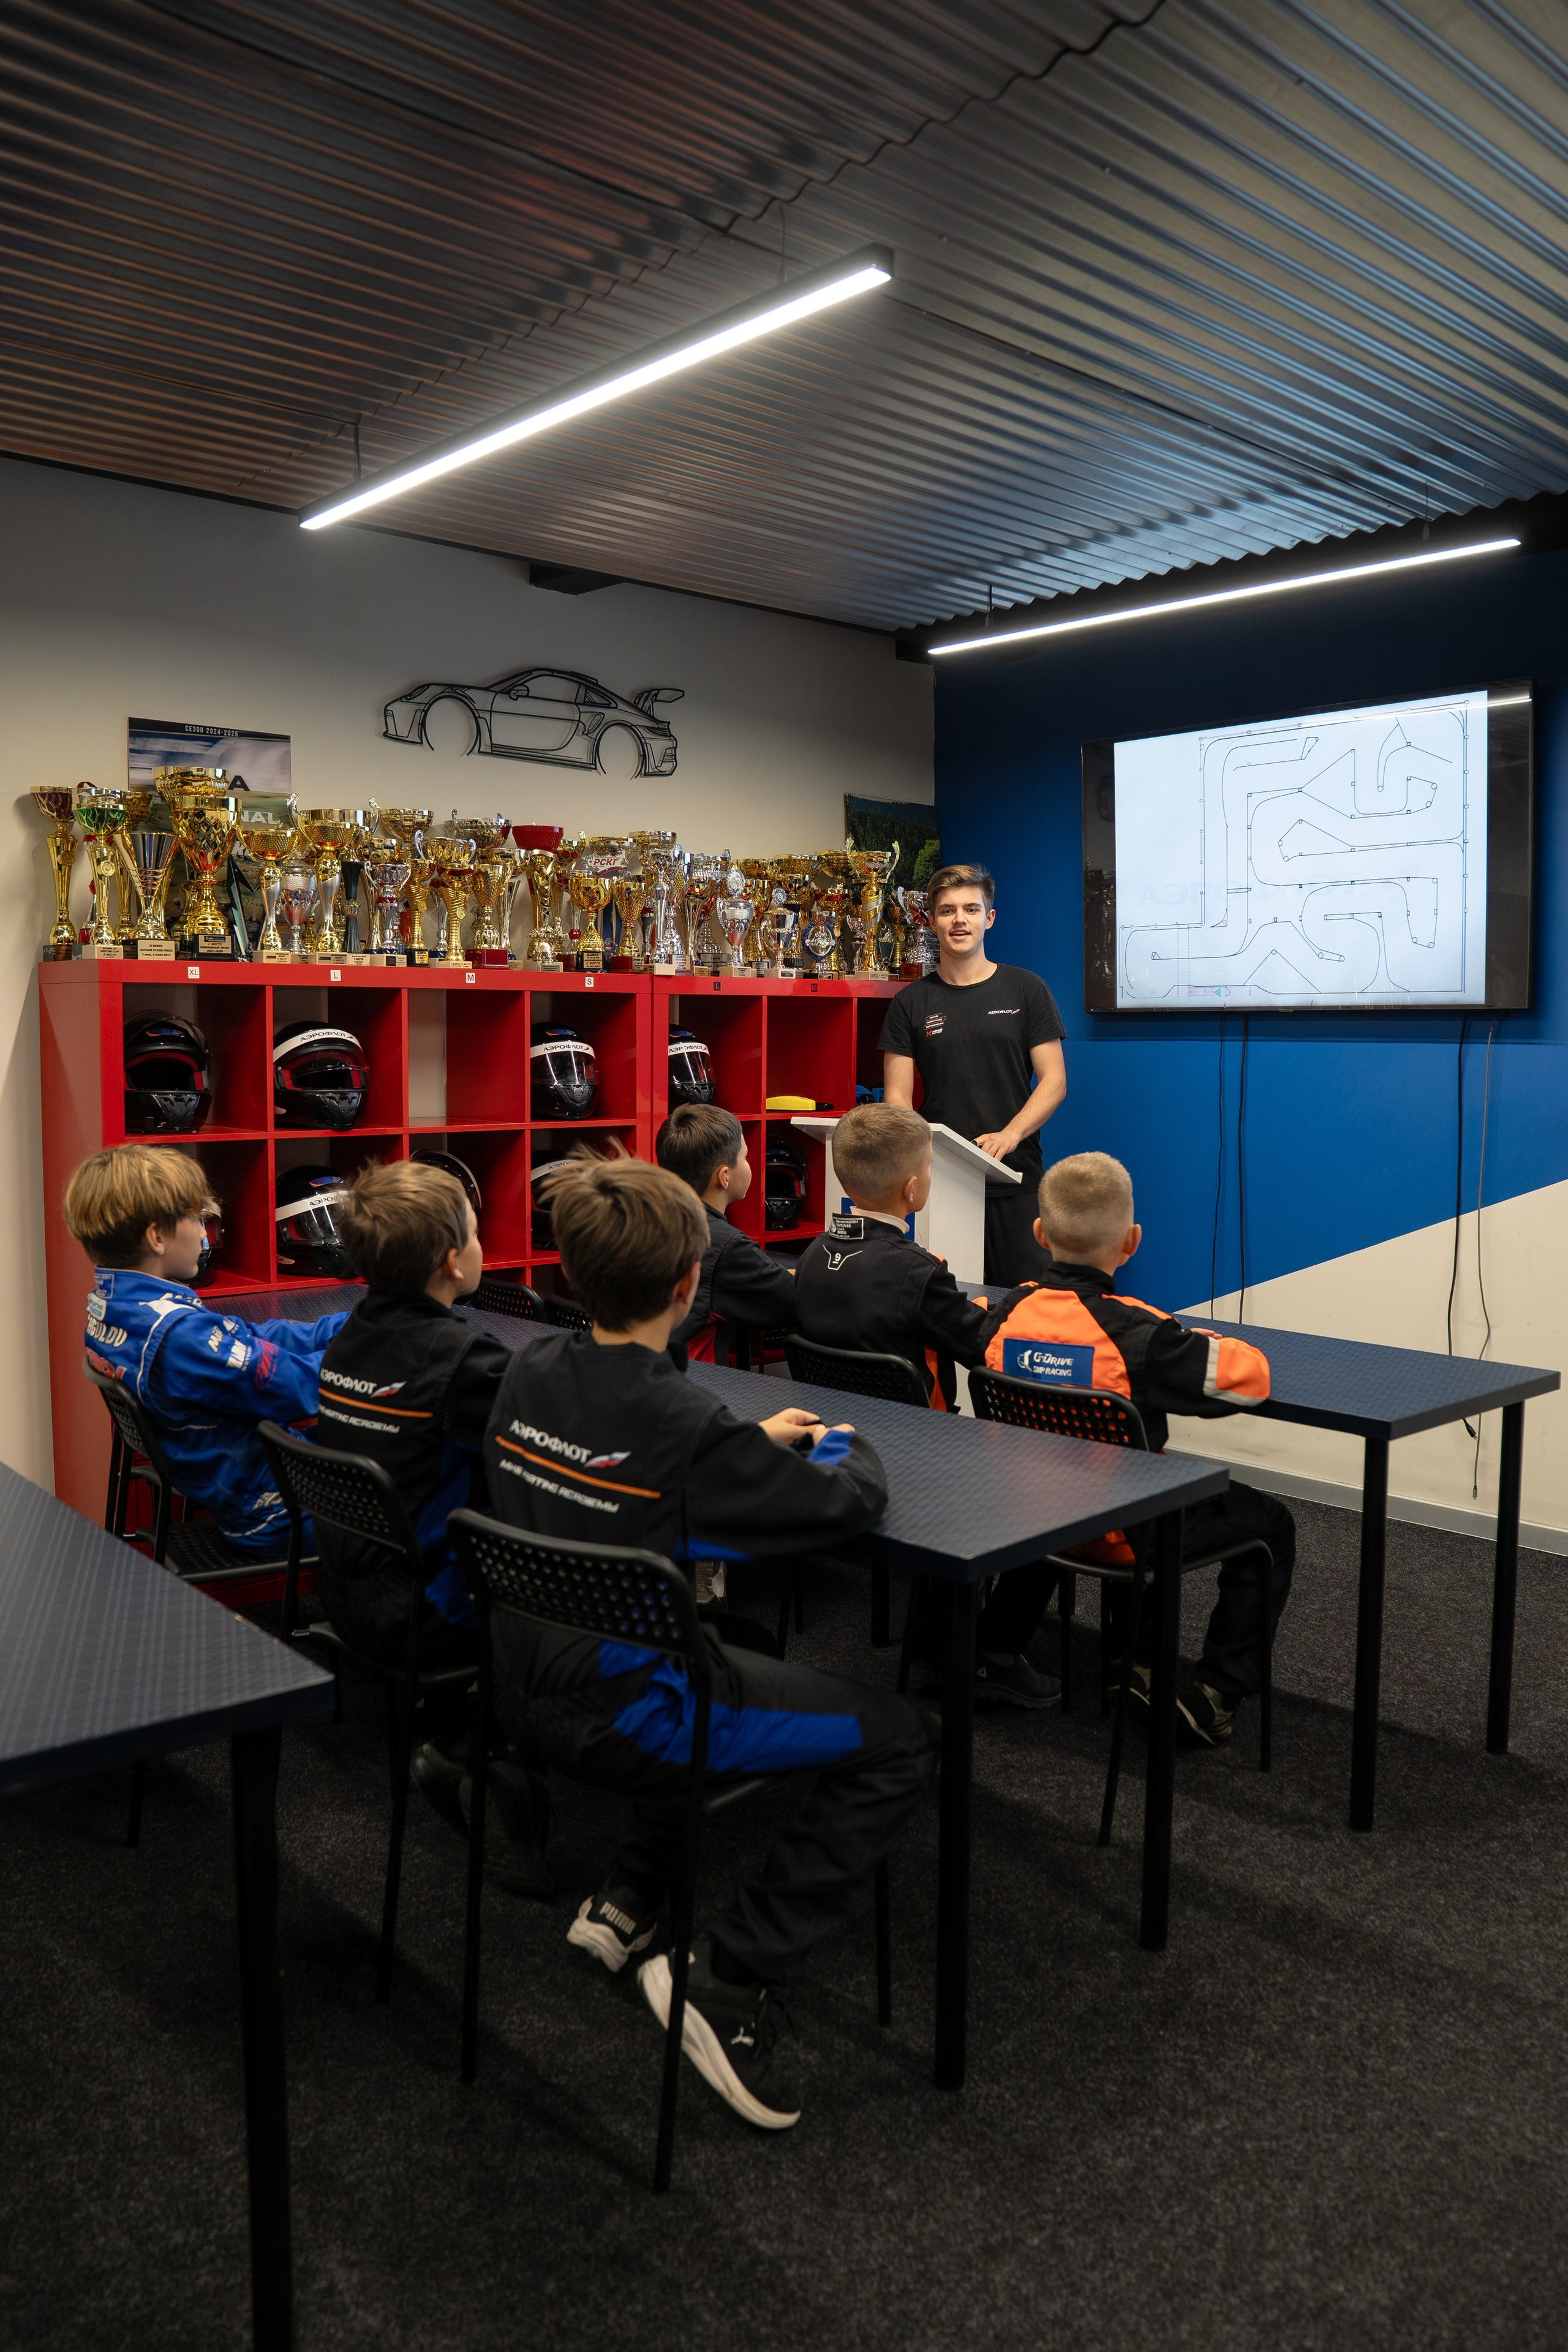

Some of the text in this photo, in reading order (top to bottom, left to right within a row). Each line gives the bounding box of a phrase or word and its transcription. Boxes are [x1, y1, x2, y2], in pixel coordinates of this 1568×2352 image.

[206, 727, 238, 737] 2024-2025
[301, 1031, 347, 1042] АЭРОФЛОТ
[669, 1045, 703, 1054] АЭРОФЛОТ
[548, 1161, 571, 1170] АЭРО
[1046, 1366, 1072, 1380] RACING
[508, 1419, 592, 1464] АЭРОФЛОТ
[600, 1901, 636, 1935] PUMA
